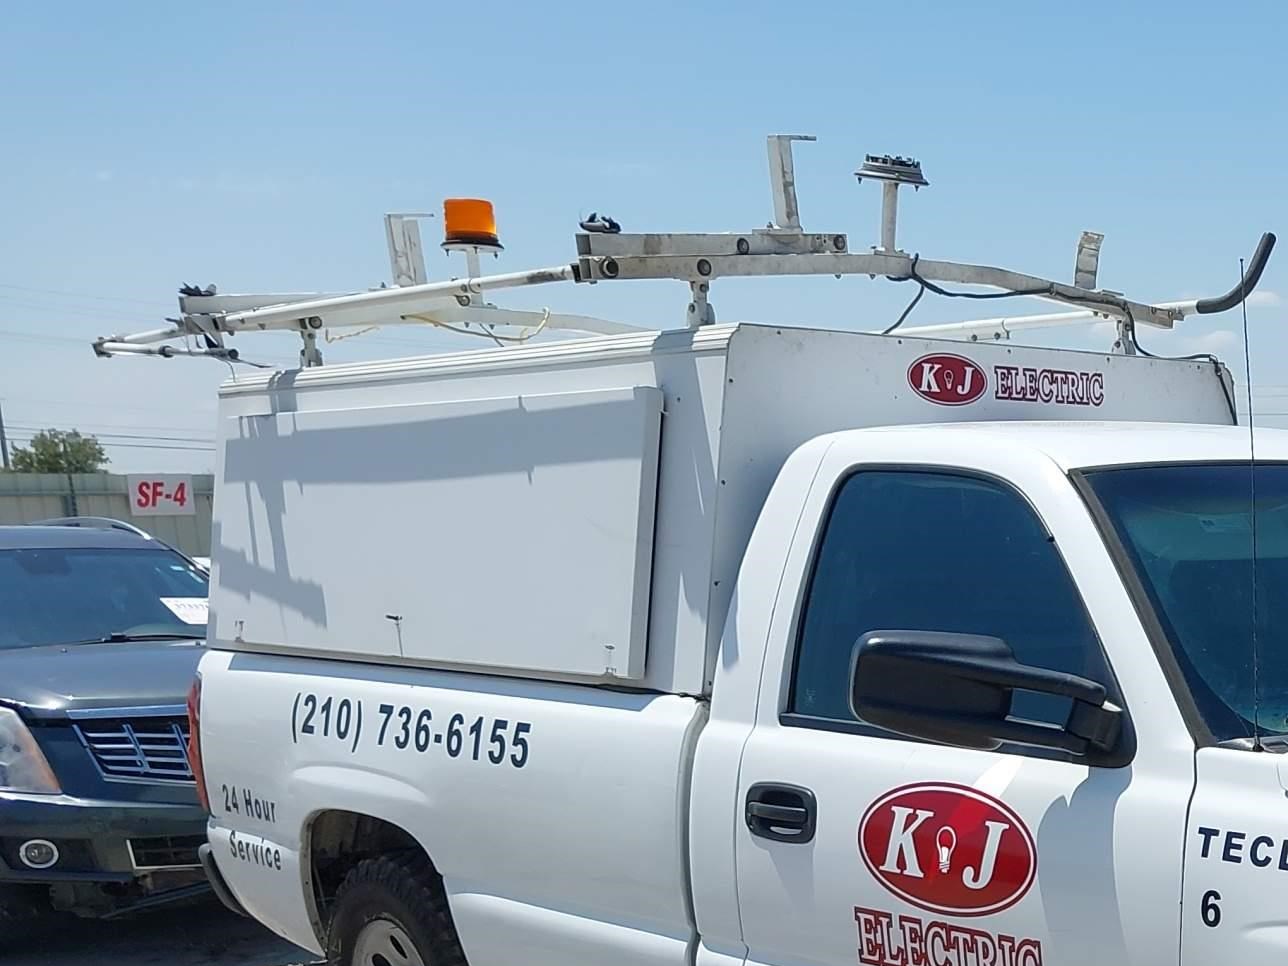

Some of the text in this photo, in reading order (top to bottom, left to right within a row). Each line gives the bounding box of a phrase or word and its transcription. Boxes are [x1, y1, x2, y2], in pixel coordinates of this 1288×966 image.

[995, 365, 1104, 406] ELECTRIC
[136, 481, 187, 508] SF-4
[291, 692, 532, 768] (210) 736-6155
[221, 783, 276, 824] 24 Hour
[228, 829, 282, 871] Service
[1200, 889, 1222, 928] 6
